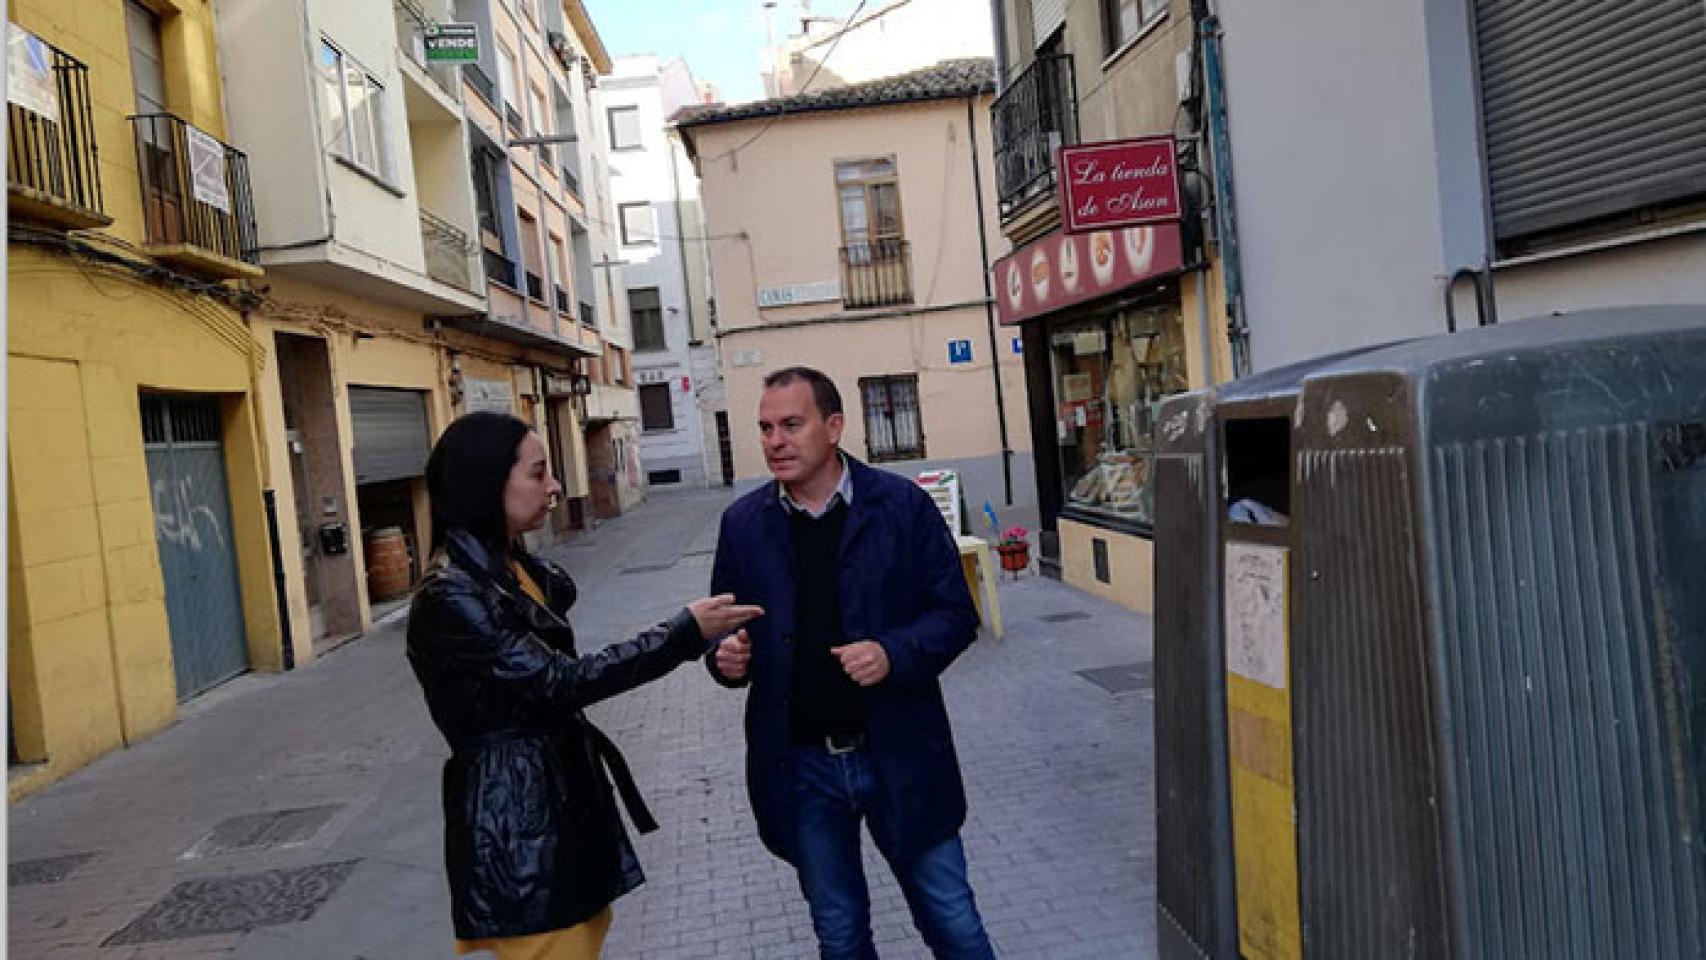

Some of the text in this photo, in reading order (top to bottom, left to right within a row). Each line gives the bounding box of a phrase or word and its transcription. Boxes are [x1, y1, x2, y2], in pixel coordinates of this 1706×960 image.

[428, 38, 474, 48] VENDE
[1074, 155, 1168, 184] La tienda
[1078, 186, 1168, 216] de Asun
